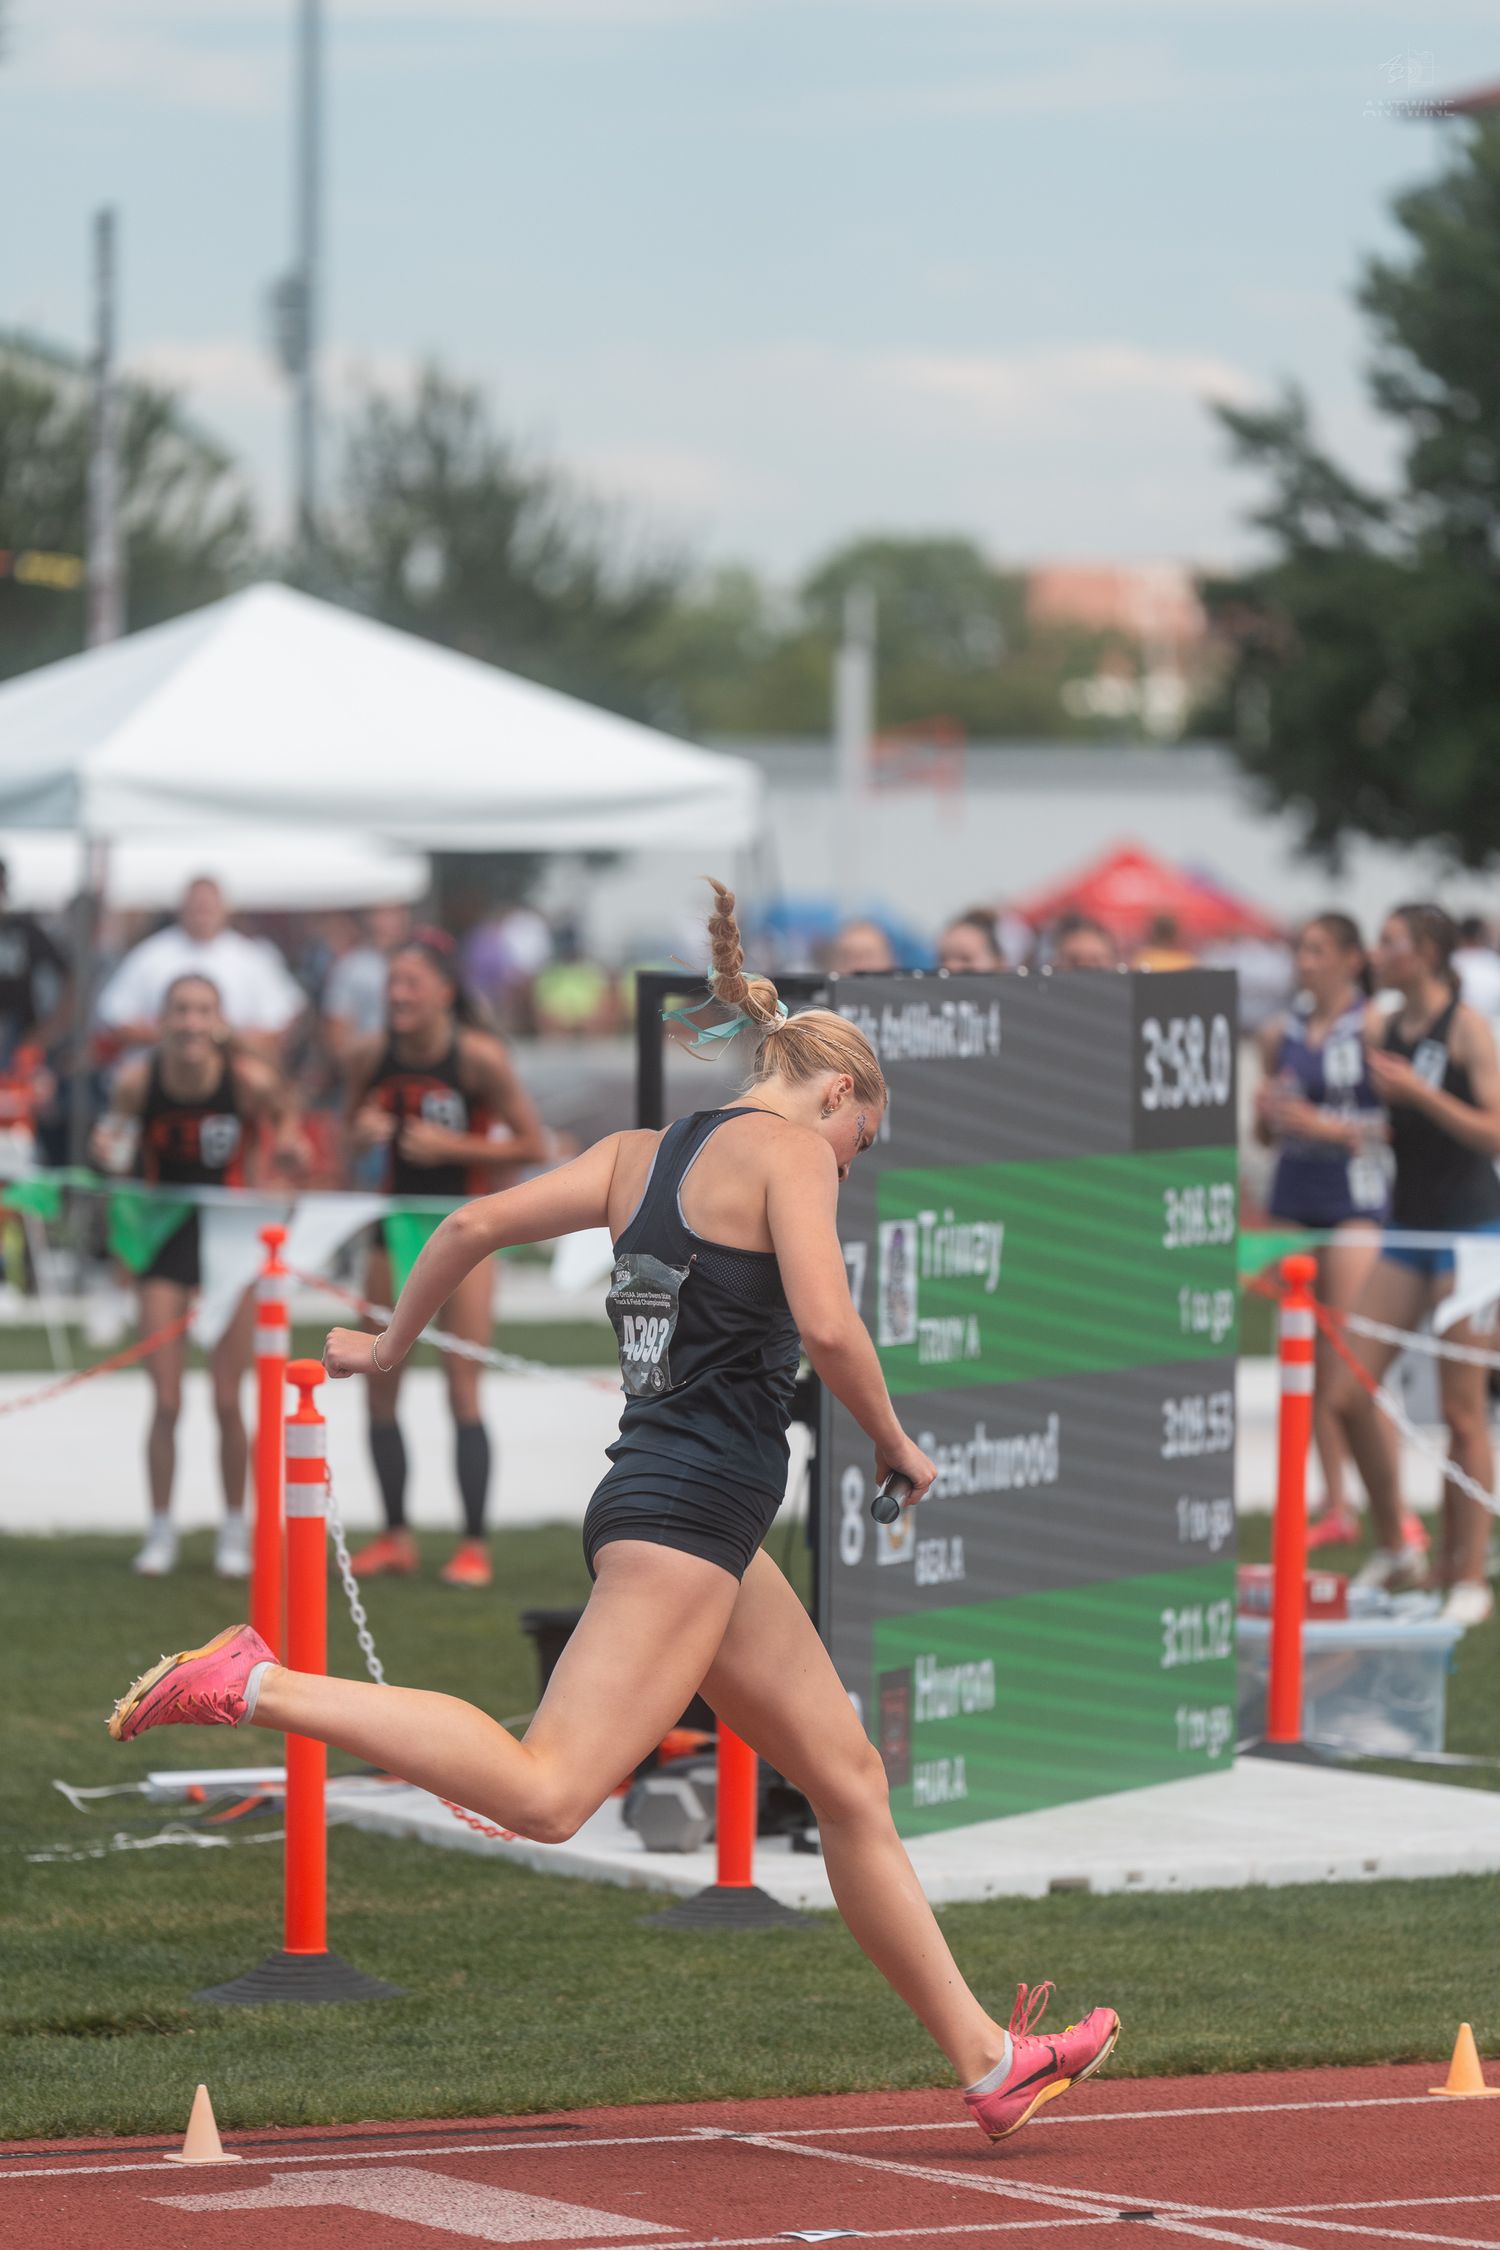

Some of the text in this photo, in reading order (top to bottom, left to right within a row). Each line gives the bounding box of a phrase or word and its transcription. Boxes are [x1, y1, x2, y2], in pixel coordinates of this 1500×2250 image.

[1141, 1014, 1231, 1110] 3:58.0
[843, 1241, 866, 1312] 7
[917, 1208, 1004, 1292] Triway
[622, 1315, 670, 1364] 4393
[840, 1465, 865, 1566] 8
[914, 1654, 996, 1723] Huron
